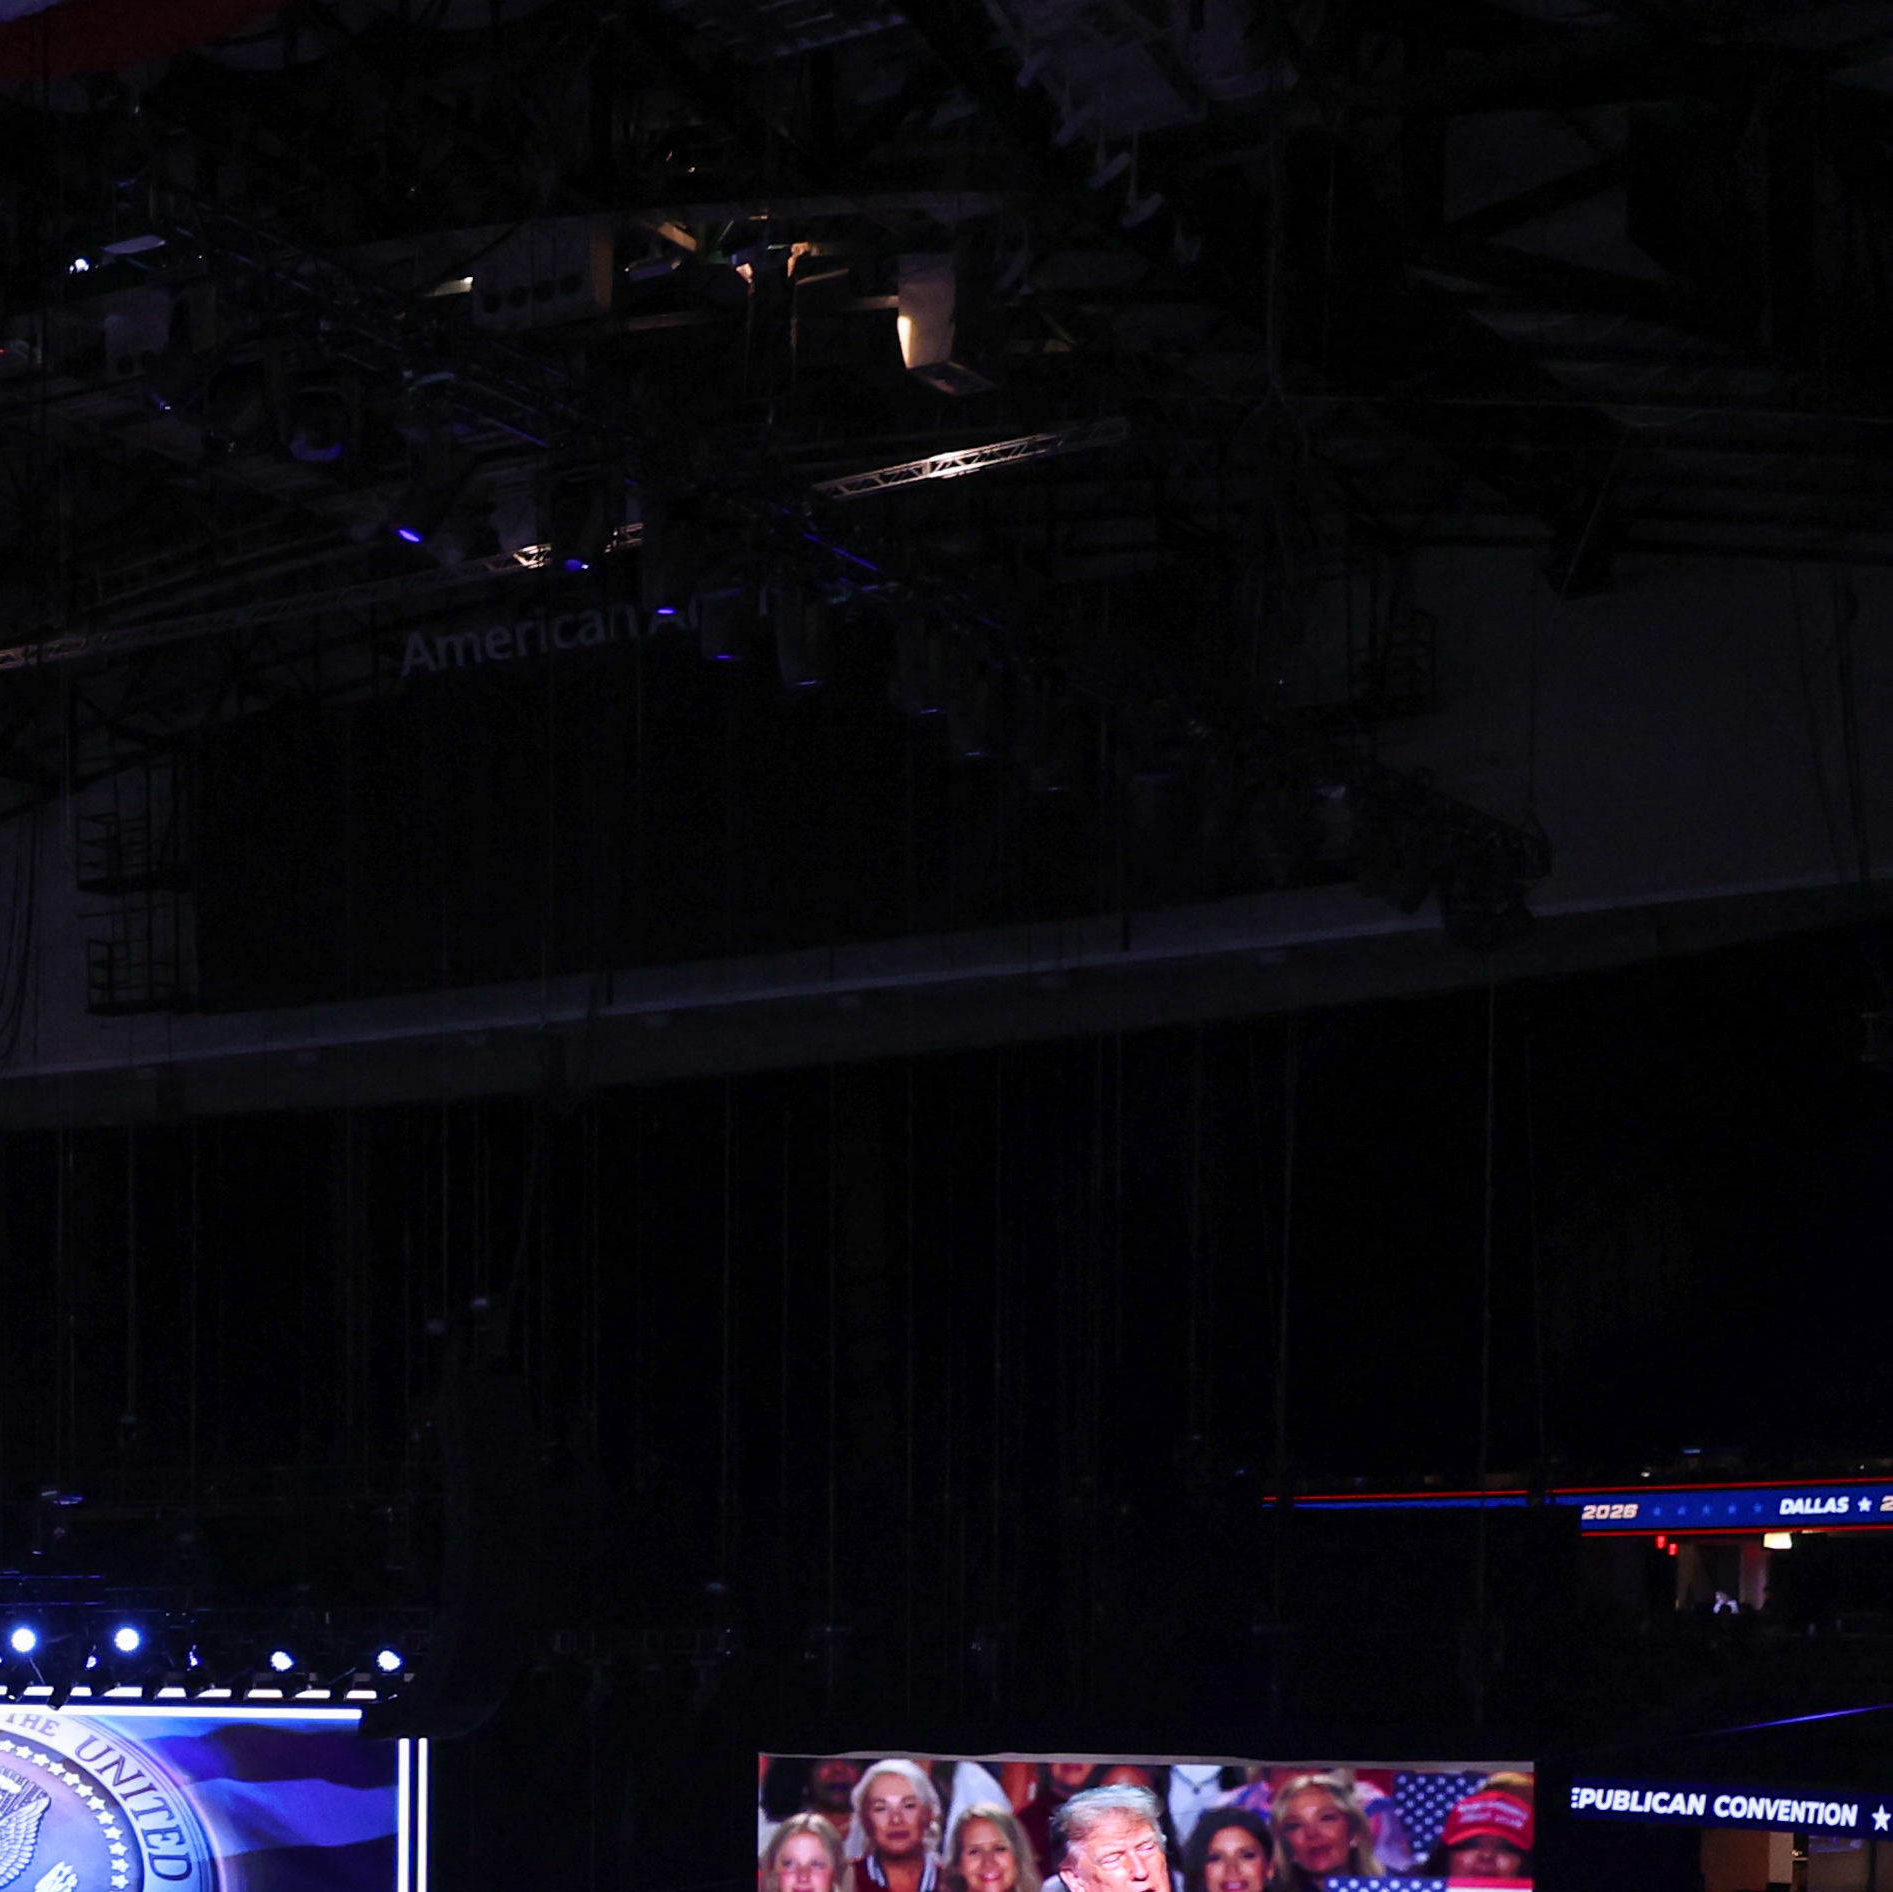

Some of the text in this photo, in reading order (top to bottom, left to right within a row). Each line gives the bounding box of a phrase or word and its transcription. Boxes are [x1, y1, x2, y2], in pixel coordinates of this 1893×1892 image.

[1581, 1503, 1639, 1521] 2026
[1779, 1496, 1849, 1515] DALLAS
[74, 1736, 192, 1882] UNITED
[1713, 1794, 1859, 1828] CONVENTION
